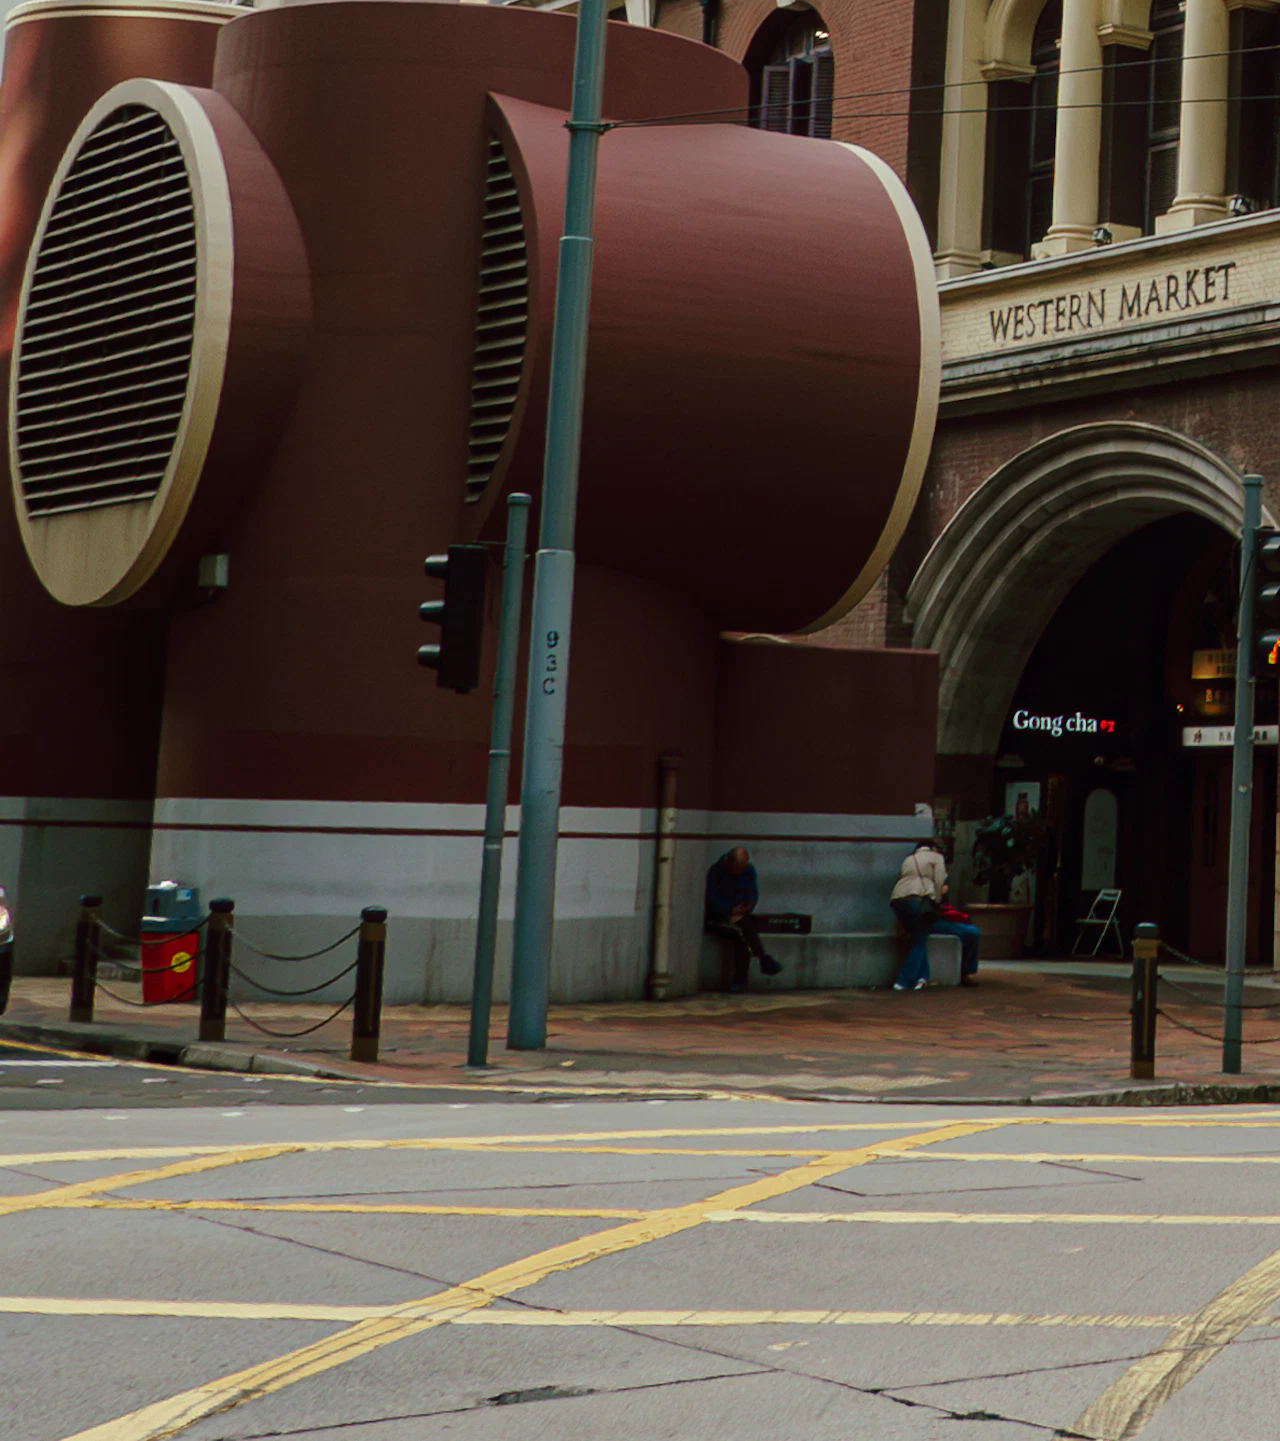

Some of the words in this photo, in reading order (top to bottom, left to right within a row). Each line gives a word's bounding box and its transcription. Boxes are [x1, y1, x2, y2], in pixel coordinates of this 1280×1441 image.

[989, 287, 1107, 342] WESTERN
[1118, 261, 1236, 321] MARKET
[1012, 709, 1064, 737] Gong
[1065, 711, 1098, 733] cha
